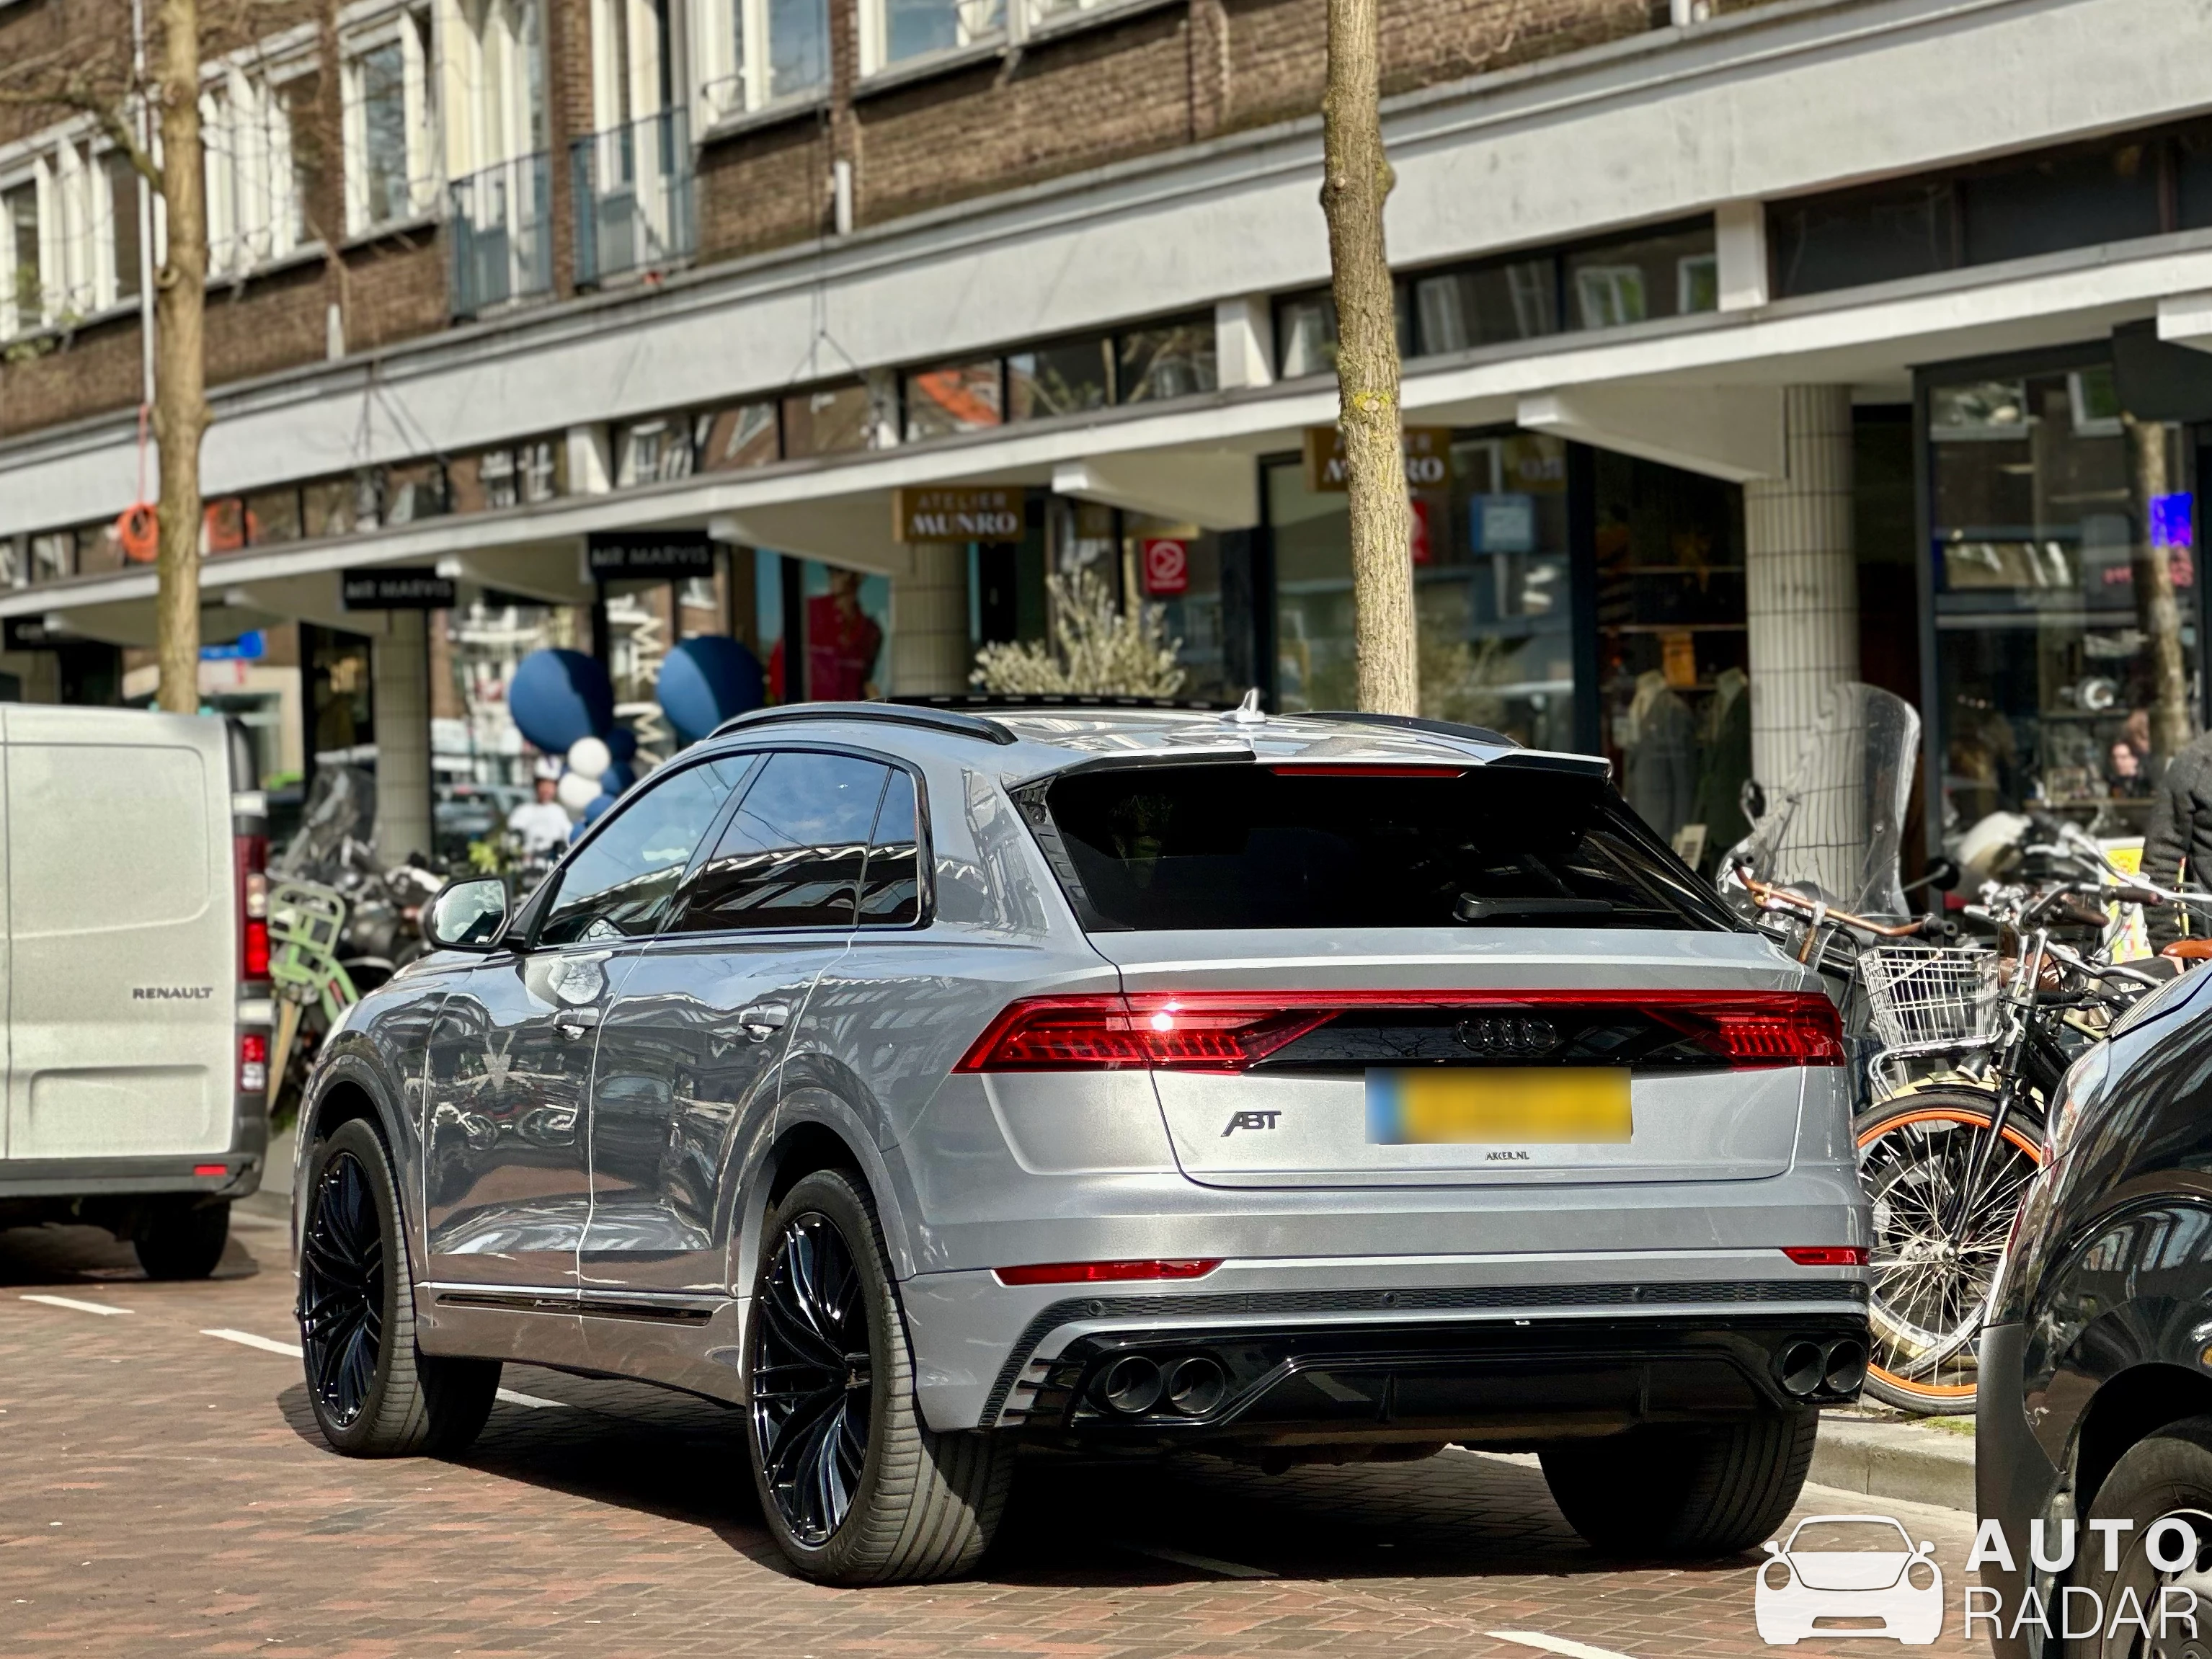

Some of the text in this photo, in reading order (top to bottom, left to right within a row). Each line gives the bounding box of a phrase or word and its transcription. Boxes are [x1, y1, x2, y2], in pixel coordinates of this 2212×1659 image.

[918, 492, 1007, 510] ATELIER
[908, 510, 1018, 535] MUNRO
[592, 546, 709, 566] MR MARVIS
[346, 579, 453, 599] MR MARVIS
[133, 987, 213, 999] RENAULT
[1220, 1111, 1282, 1137] ABT
